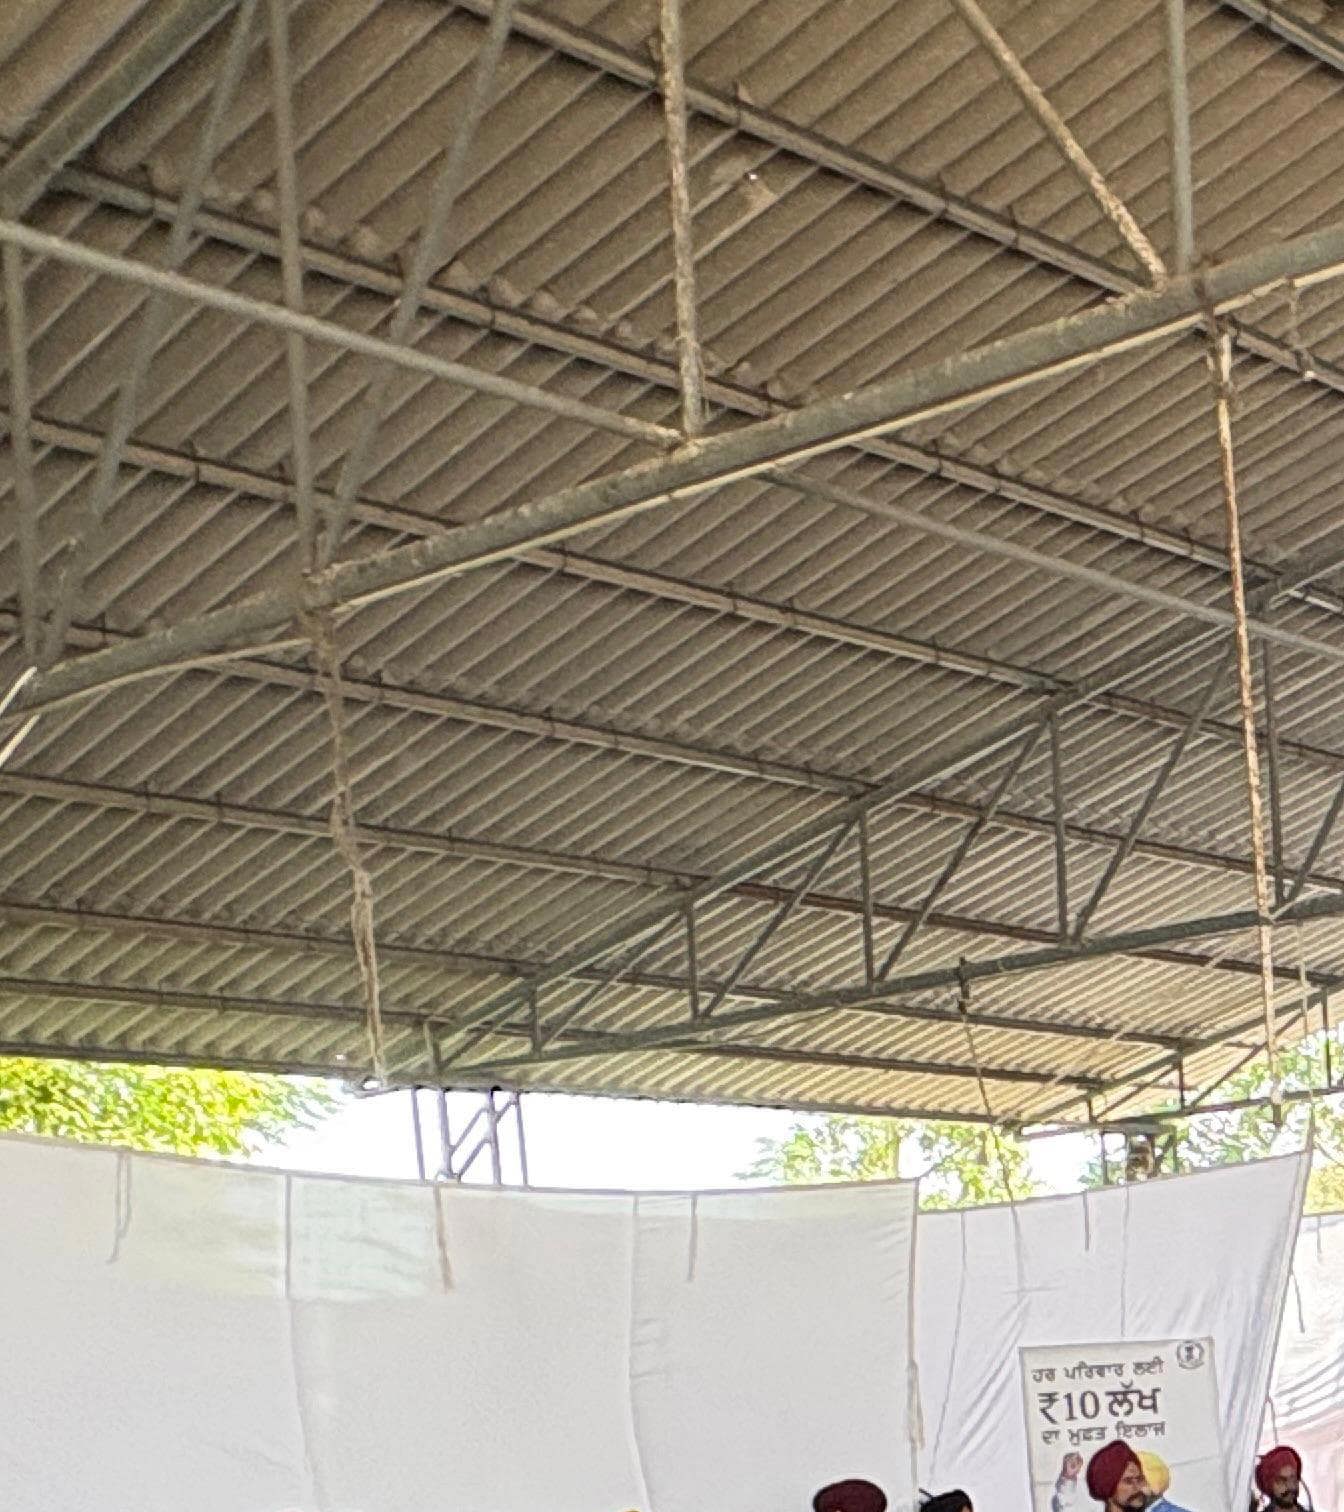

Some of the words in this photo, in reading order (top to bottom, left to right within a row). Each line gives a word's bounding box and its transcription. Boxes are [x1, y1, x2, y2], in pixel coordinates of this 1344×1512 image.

[1031, 1367, 1057, 1383] ਹਰ
[1063, 1360, 1125, 1381] ਪਰਿਵਾਰ
[1133, 1355, 1165, 1376] ਲਈ
[1037, 1390, 1100, 1425] ₹10
[1105, 1380, 1162, 1418] ਲੱਖ
[1041, 1429, 1060, 1445] ਦਾ
[1115, 1420, 1166, 1440] ਇਲਾਜ
